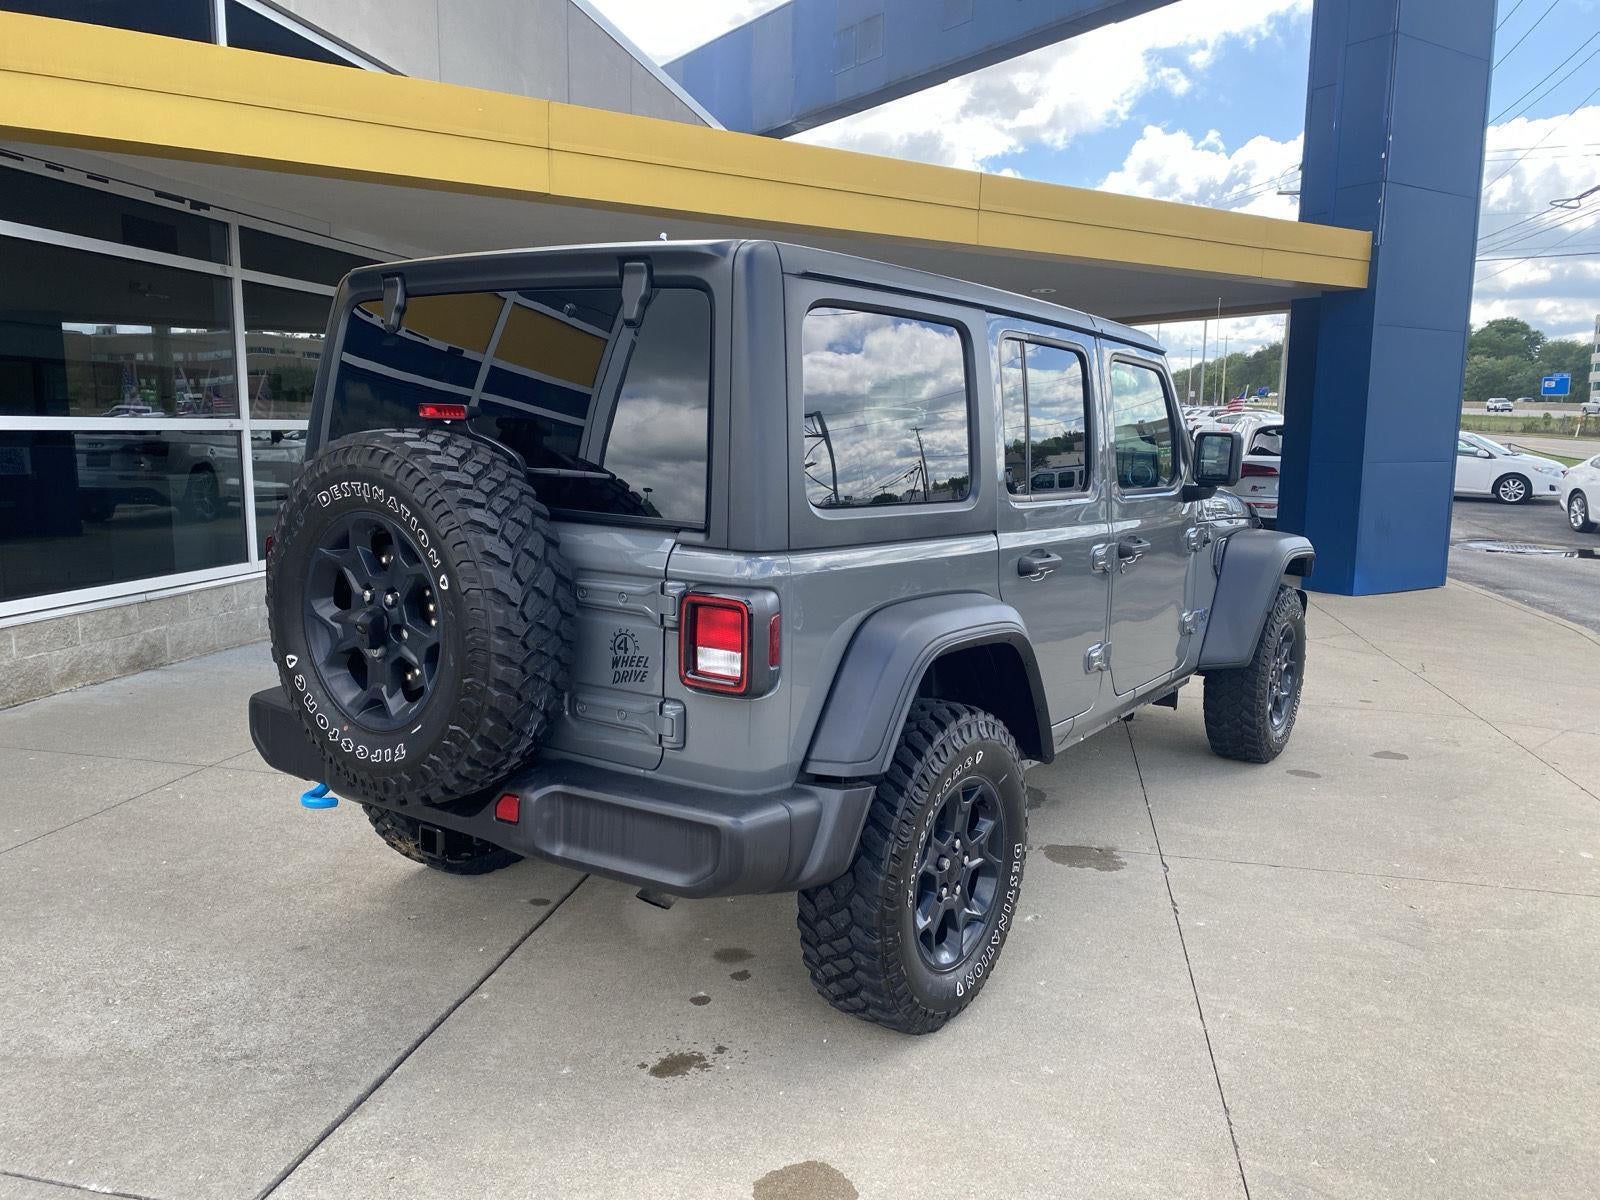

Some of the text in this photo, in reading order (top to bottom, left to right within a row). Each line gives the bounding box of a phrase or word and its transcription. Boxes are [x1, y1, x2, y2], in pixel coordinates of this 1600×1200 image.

[317, 481, 440, 568] DESTINATION
[617, 636, 629, 655] 4
[611, 655, 650, 670] WHEEL
[612, 669, 649, 685] DRIVE
[966, 843, 1022, 990] DESTINATION
